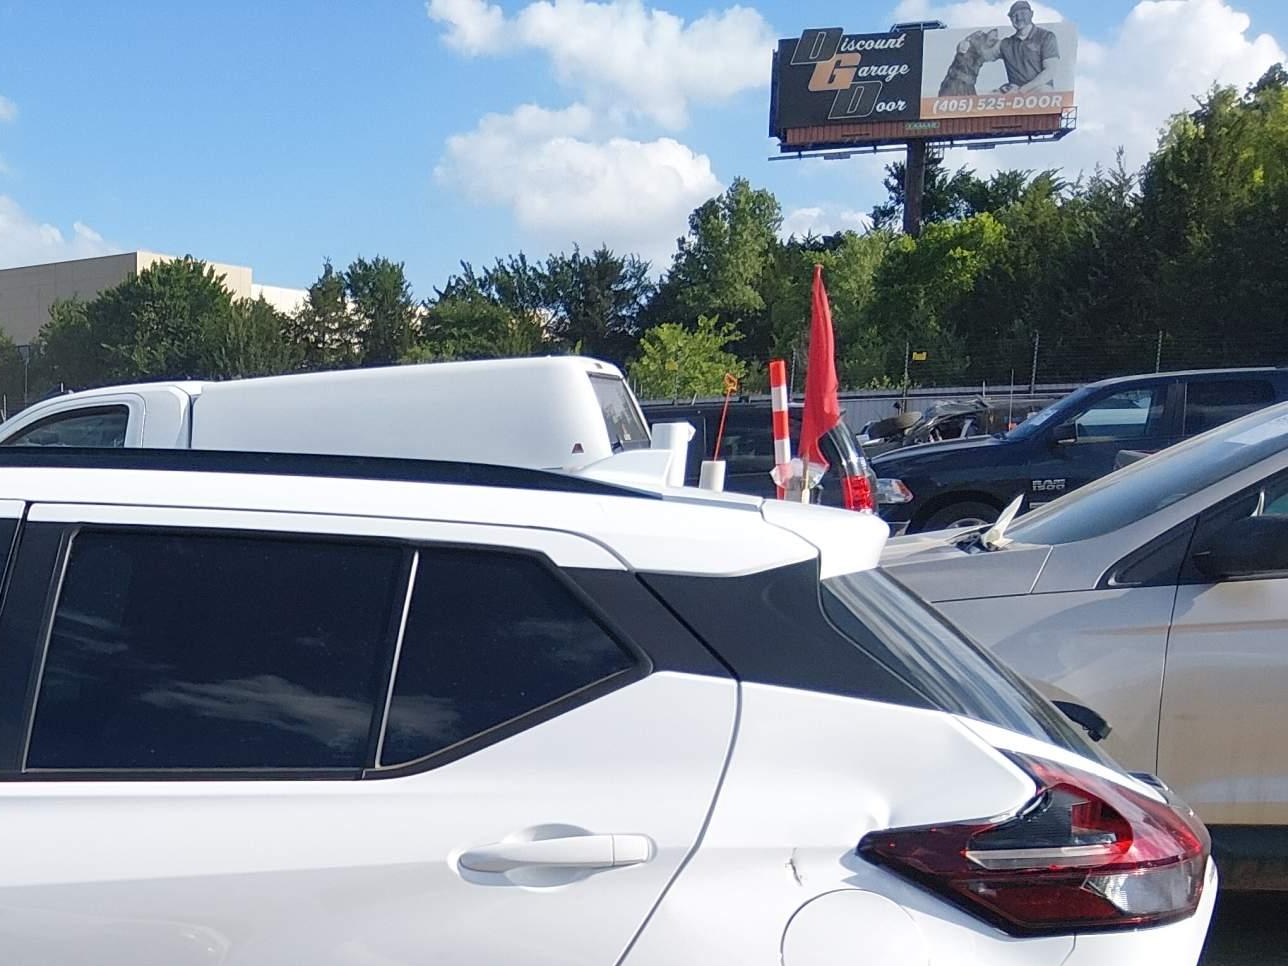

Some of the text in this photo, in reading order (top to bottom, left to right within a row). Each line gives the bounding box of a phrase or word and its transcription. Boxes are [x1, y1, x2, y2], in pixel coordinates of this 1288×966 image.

[790, 27, 907, 65] Discount
[808, 53, 910, 91] Garage
[828, 81, 907, 119] Door
[932, 95, 1062, 114] (405) 525-DOOR
